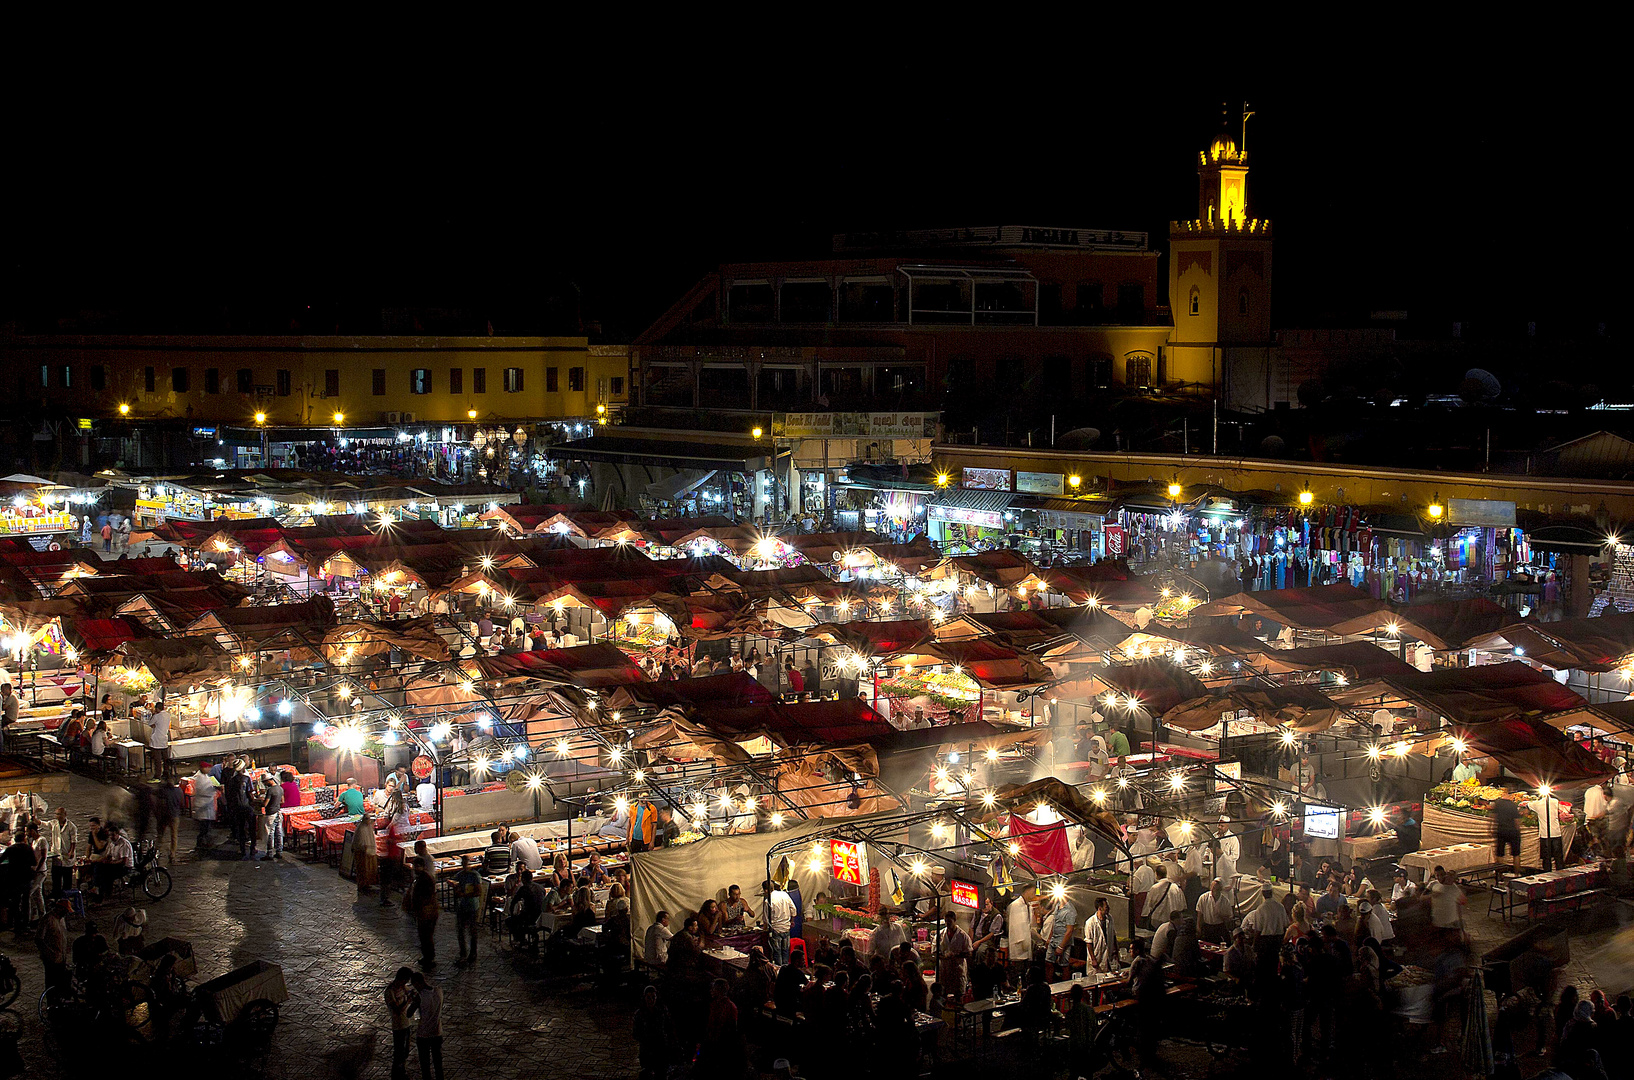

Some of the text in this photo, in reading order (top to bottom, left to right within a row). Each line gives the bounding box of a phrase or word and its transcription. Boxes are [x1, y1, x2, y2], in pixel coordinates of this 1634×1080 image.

[1020, 228, 1079, 245] ARGANA
[786, 414, 803, 427] Souk
[804, 414, 813, 427] El
[1108, 531, 1122, 554] Cola
[823, 665, 837, 679] 22
[954, 881, 975, 891] حسن
[953, 893, 979, 909] HASSAN
